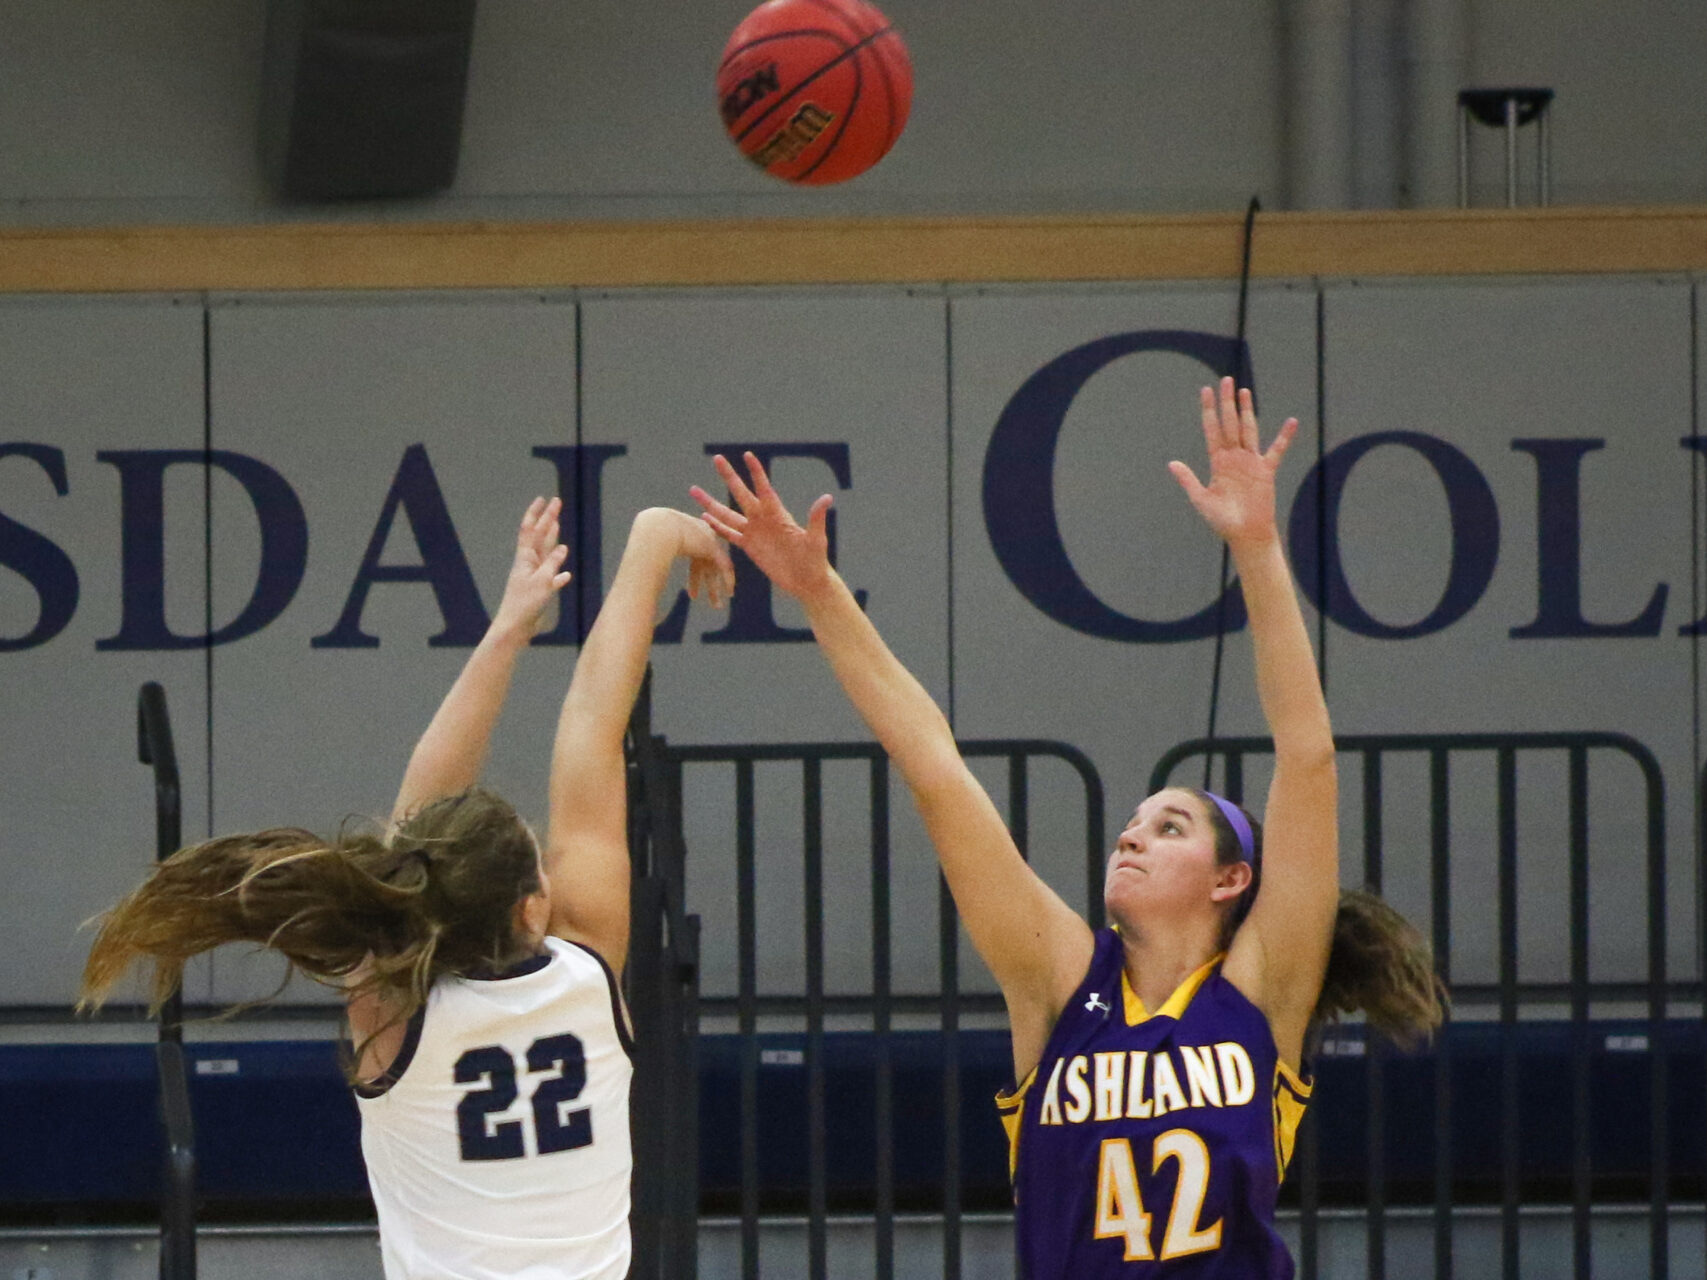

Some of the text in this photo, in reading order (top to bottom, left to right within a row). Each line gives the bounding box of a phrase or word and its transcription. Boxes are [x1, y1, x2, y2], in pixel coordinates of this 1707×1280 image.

[981, 328, 1707, 645] COL
[453, 1032, 594, 1162] 22
[1039, 1041, 1256, 1126] ASHLAND
[1093, 1128, 1224, 1263] 42
